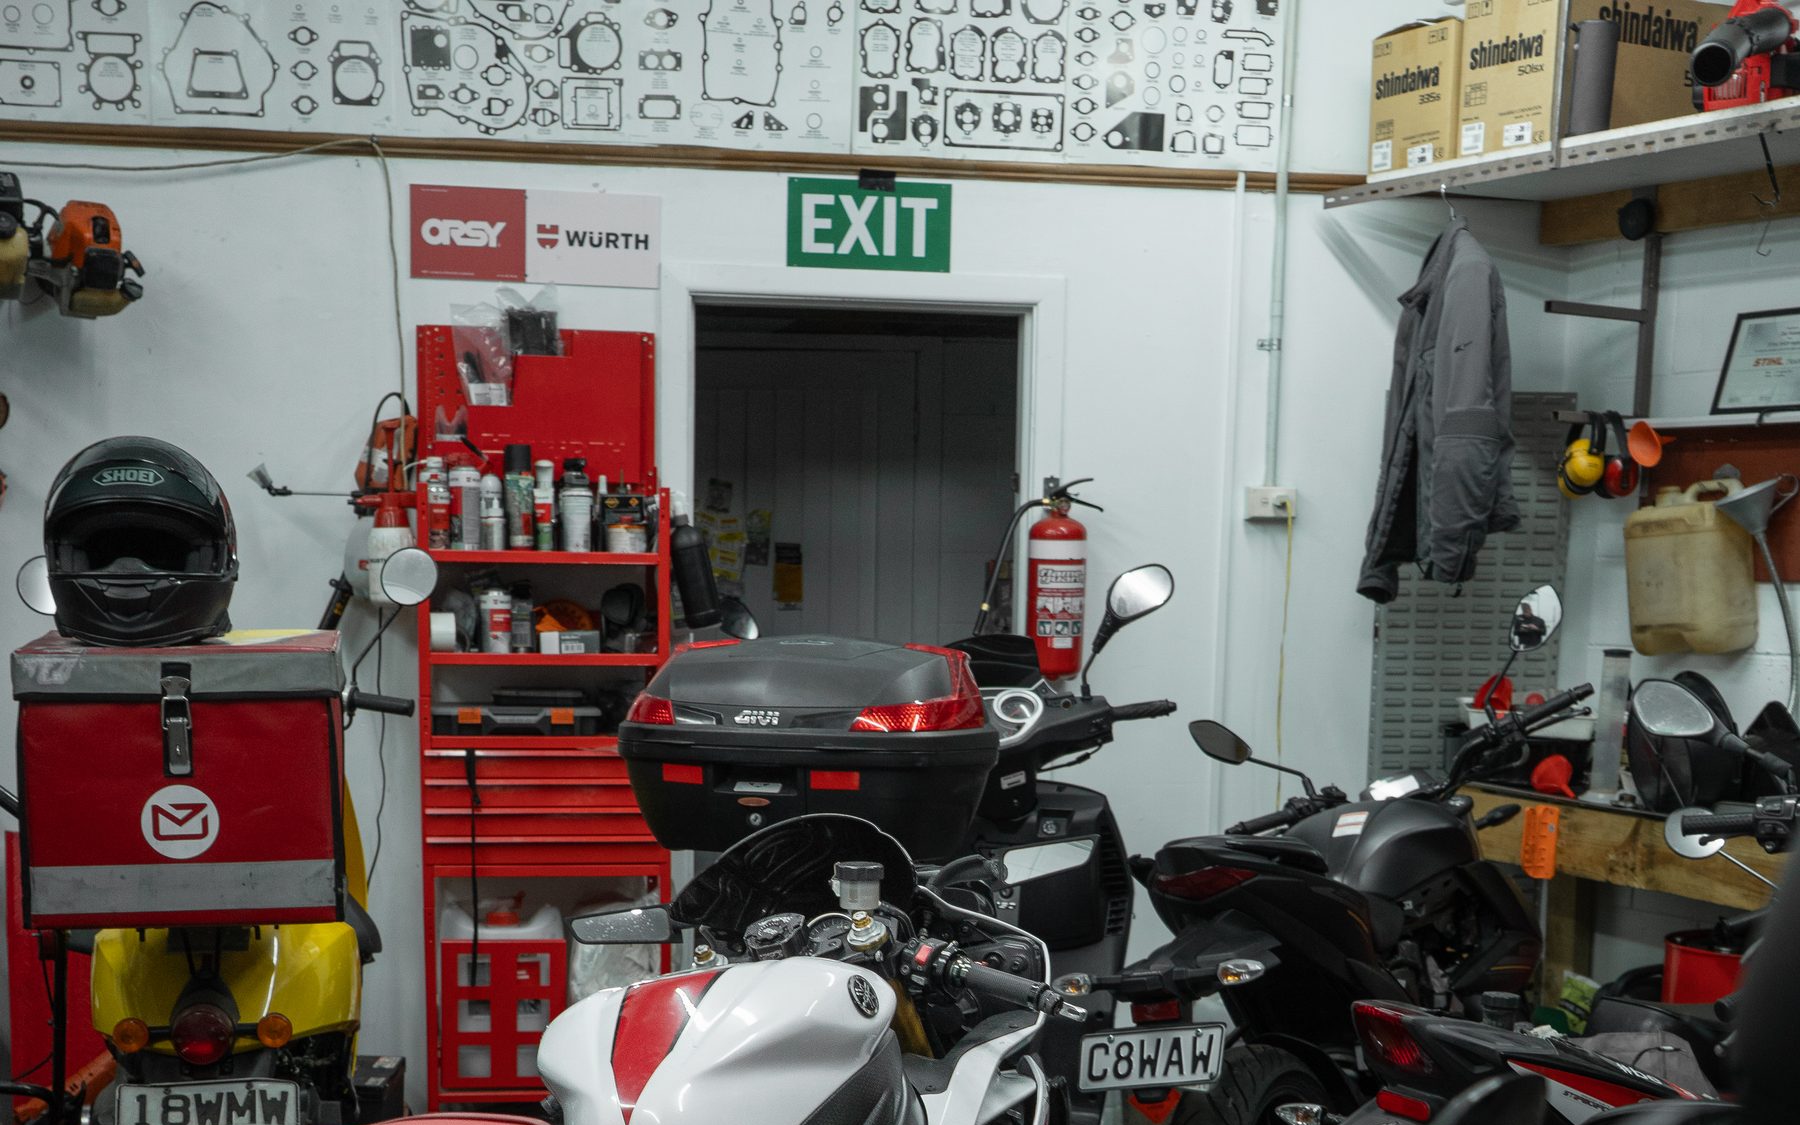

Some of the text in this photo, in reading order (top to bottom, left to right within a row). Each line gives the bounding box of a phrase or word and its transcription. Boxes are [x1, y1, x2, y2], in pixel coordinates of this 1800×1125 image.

[1470, 32, 1543, 70] shindaiwa
[1375, 65, 1440, 100] shindaiwa
[421, 218, 507, 248] ORSY
[801, 193, 938, 258] EXIT
[102, 469, 155, 483] SHOEI
[734, 709, 780, 726] GIVI
[1087, 1033, 1215, 1083] C8WAW
